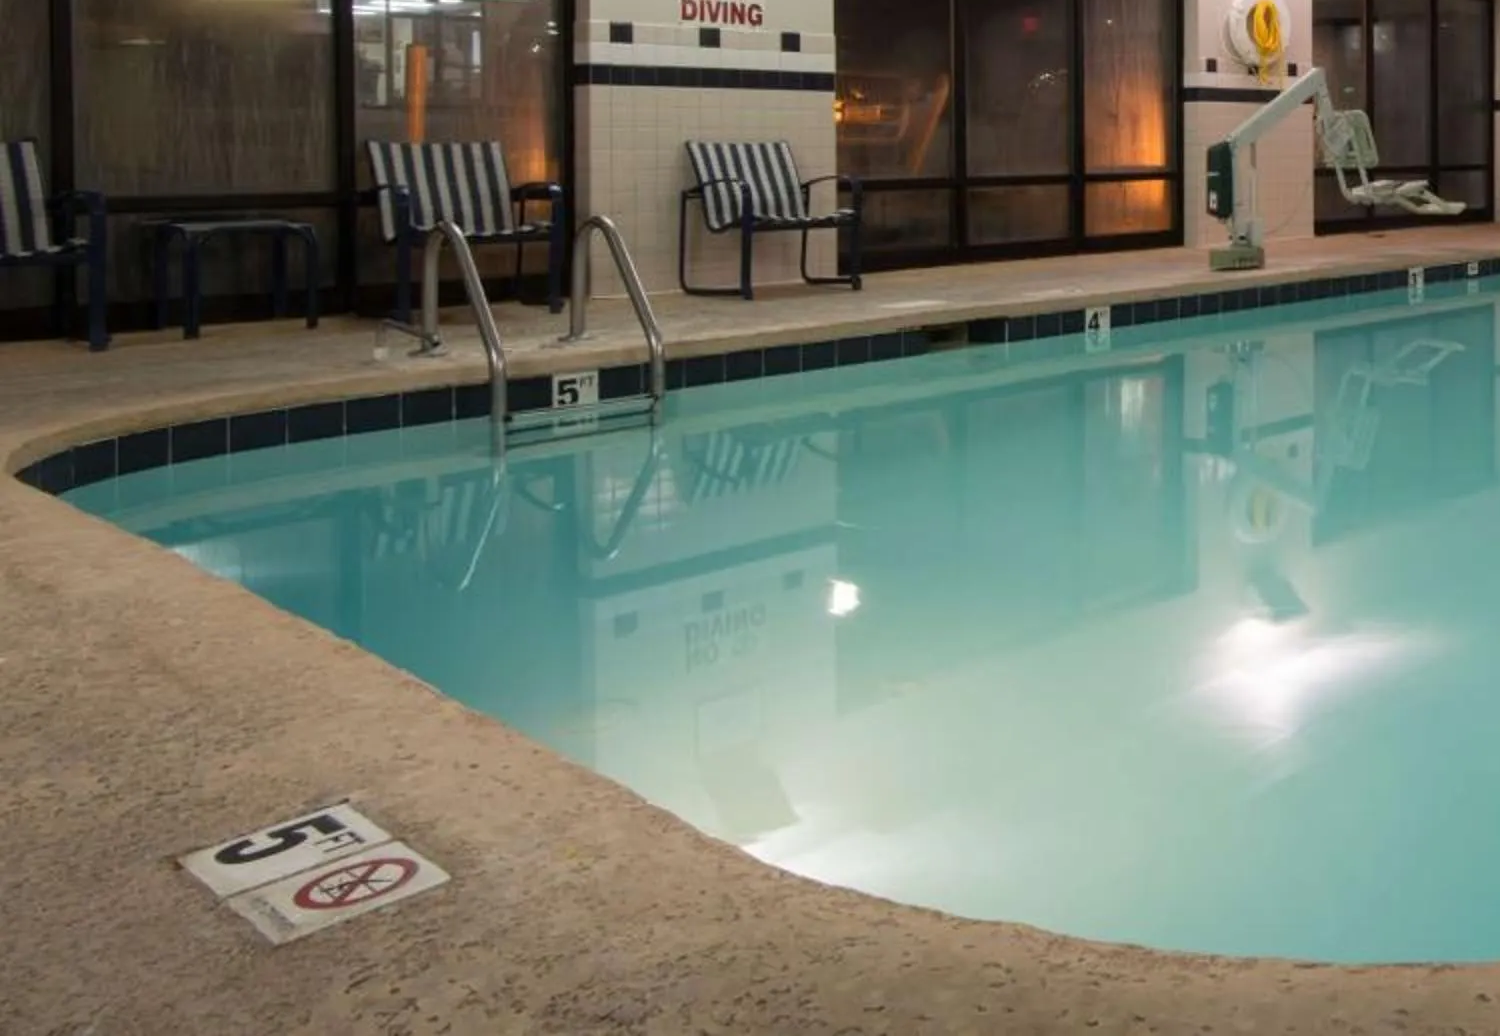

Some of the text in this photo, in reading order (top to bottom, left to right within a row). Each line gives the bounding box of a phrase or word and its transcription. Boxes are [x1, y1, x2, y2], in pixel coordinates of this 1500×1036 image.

[1088, 311, 1100, 330] 4
[558, 378, 578, 405] 5
[213, 813, 347, 865] 5
